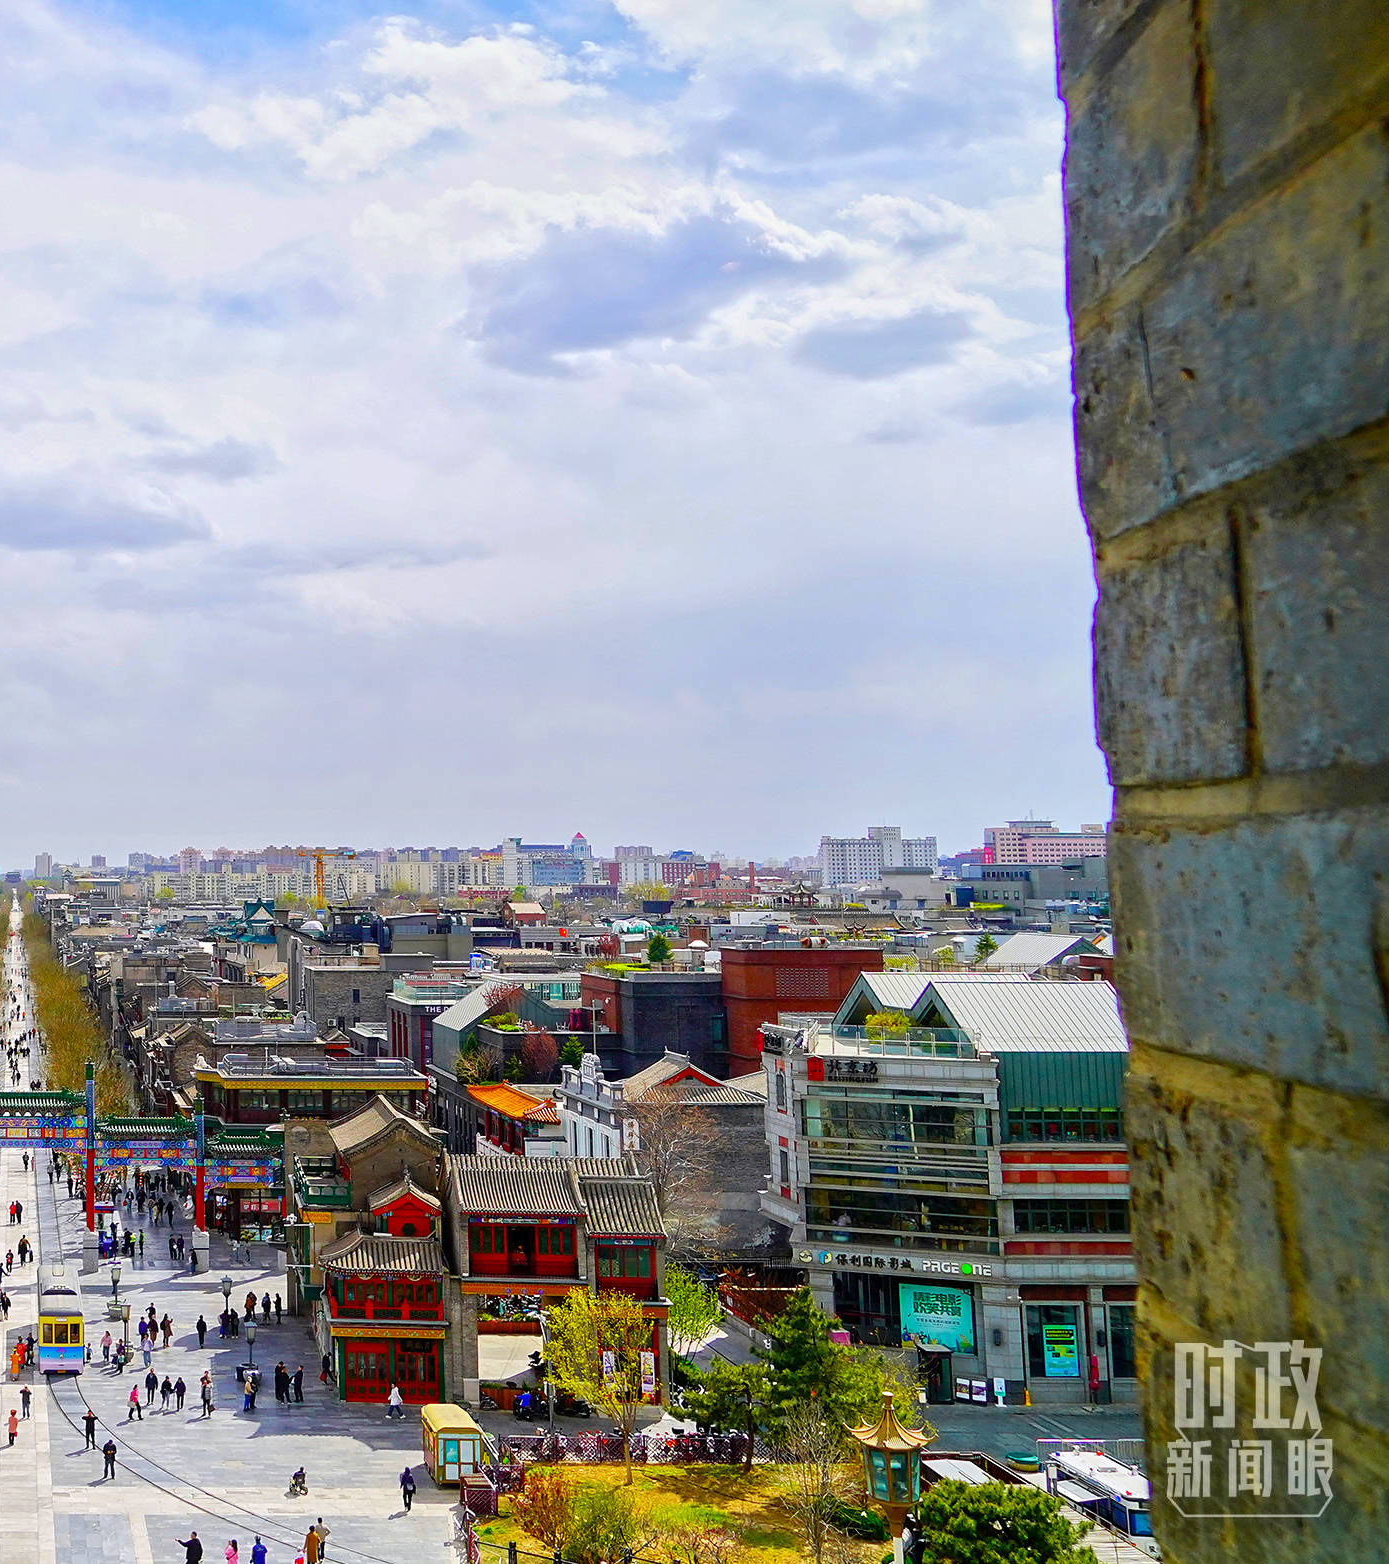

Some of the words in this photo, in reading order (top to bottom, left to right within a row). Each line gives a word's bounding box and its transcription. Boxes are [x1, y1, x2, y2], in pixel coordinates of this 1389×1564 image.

[827, 1059, 878, 1075] 北京坊
[835, 1253, 914, 1271] 保利国际影城
